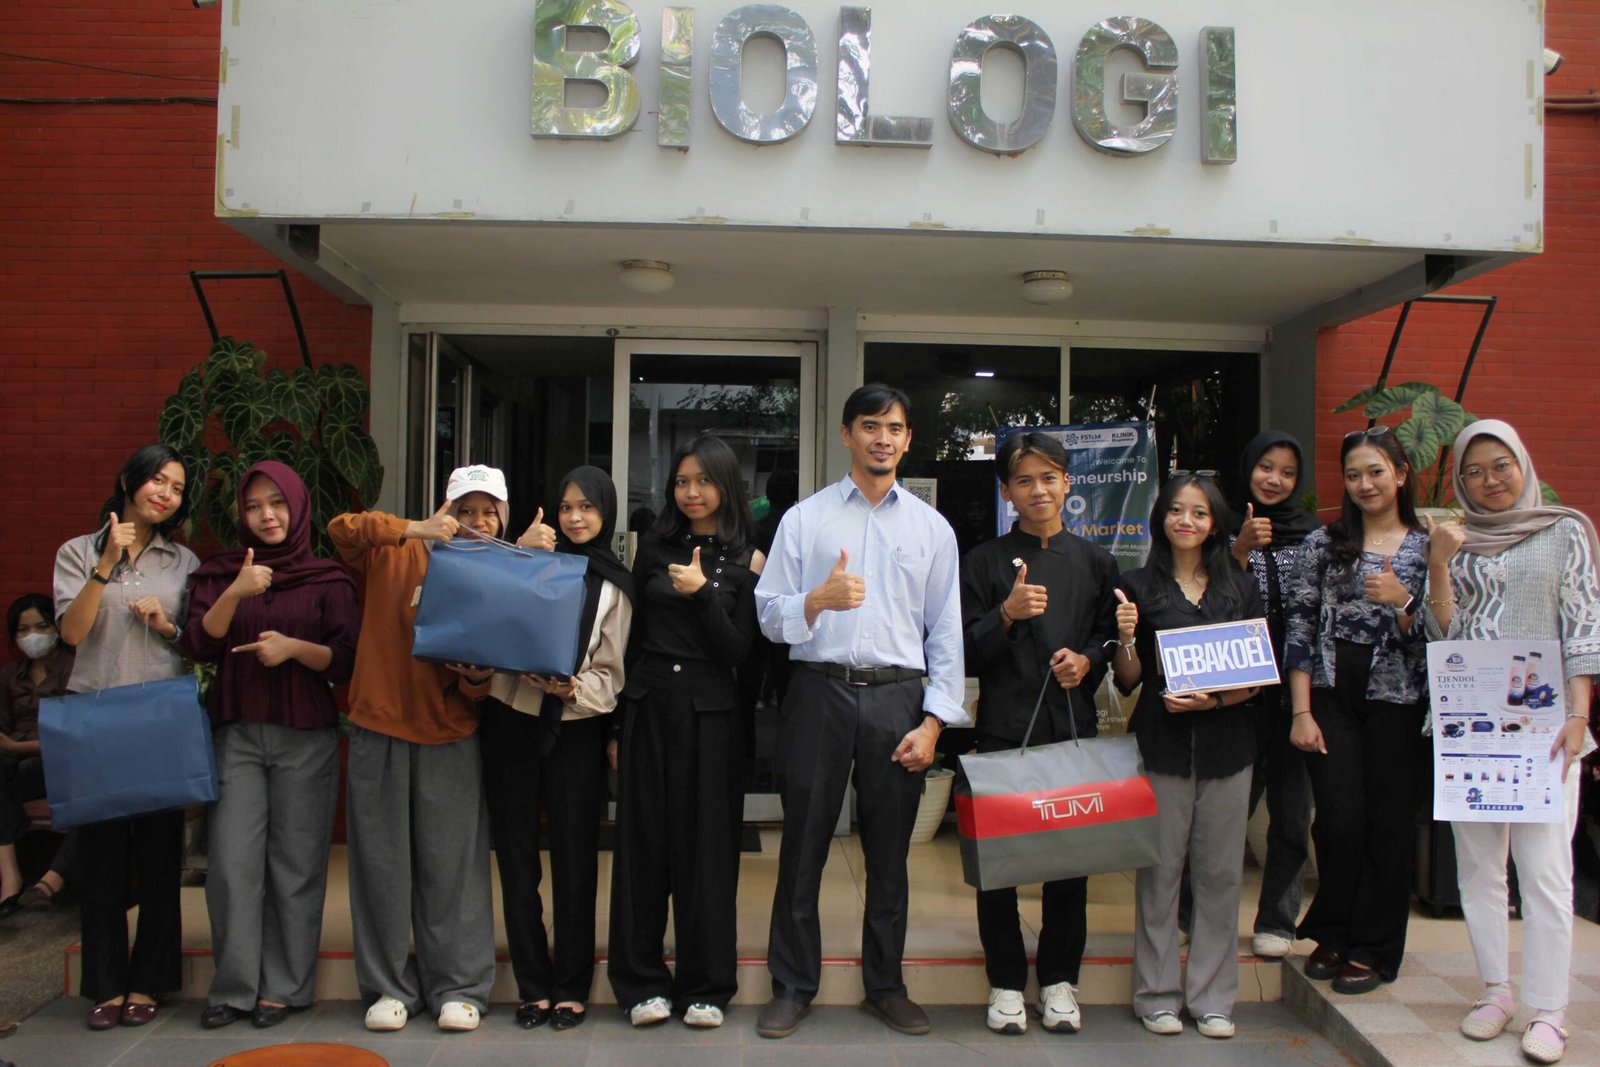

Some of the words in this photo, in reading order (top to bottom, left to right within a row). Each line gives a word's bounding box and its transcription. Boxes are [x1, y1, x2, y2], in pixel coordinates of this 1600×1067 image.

[531, 0, 1238, 165] BIOLOGI
[1111, 431, 1134, 439] KLINIK
[1096, 456, 1135, 466] Welcome
[1136, 455, 1147, 464] To
[1069, 468, 1148, 485] eneurship
[1081, 521, 1144, 537] Market
[1163, 636, 1273, 678] DEBAKOEL
[1437, 675, 1477, 684] TJENDOL
[1032, 792, 1104, 820] TUMI
